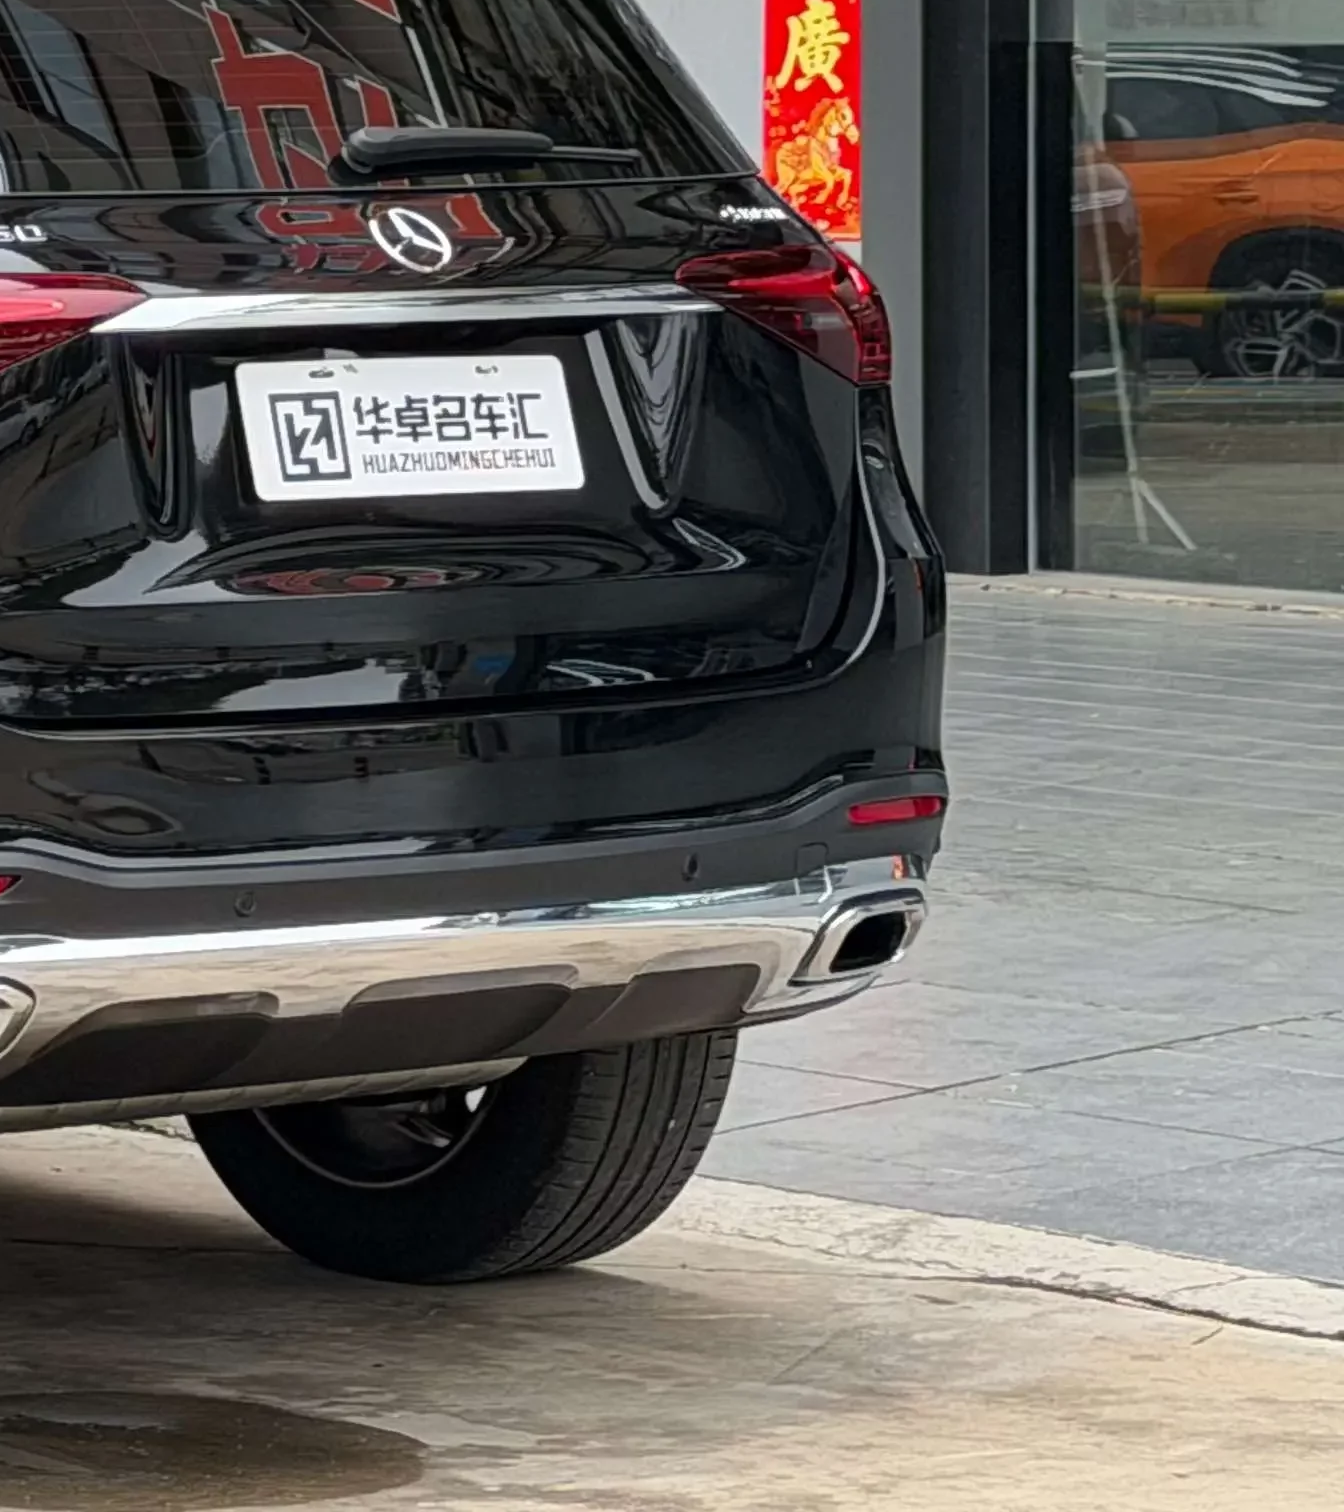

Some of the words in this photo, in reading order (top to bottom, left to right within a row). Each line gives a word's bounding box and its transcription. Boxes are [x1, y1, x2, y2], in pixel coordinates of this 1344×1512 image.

[352, 391, 550, 445] 华卓名车汇
[362, 446, 557, 474] HUAZHUOMINGCHEHUI
